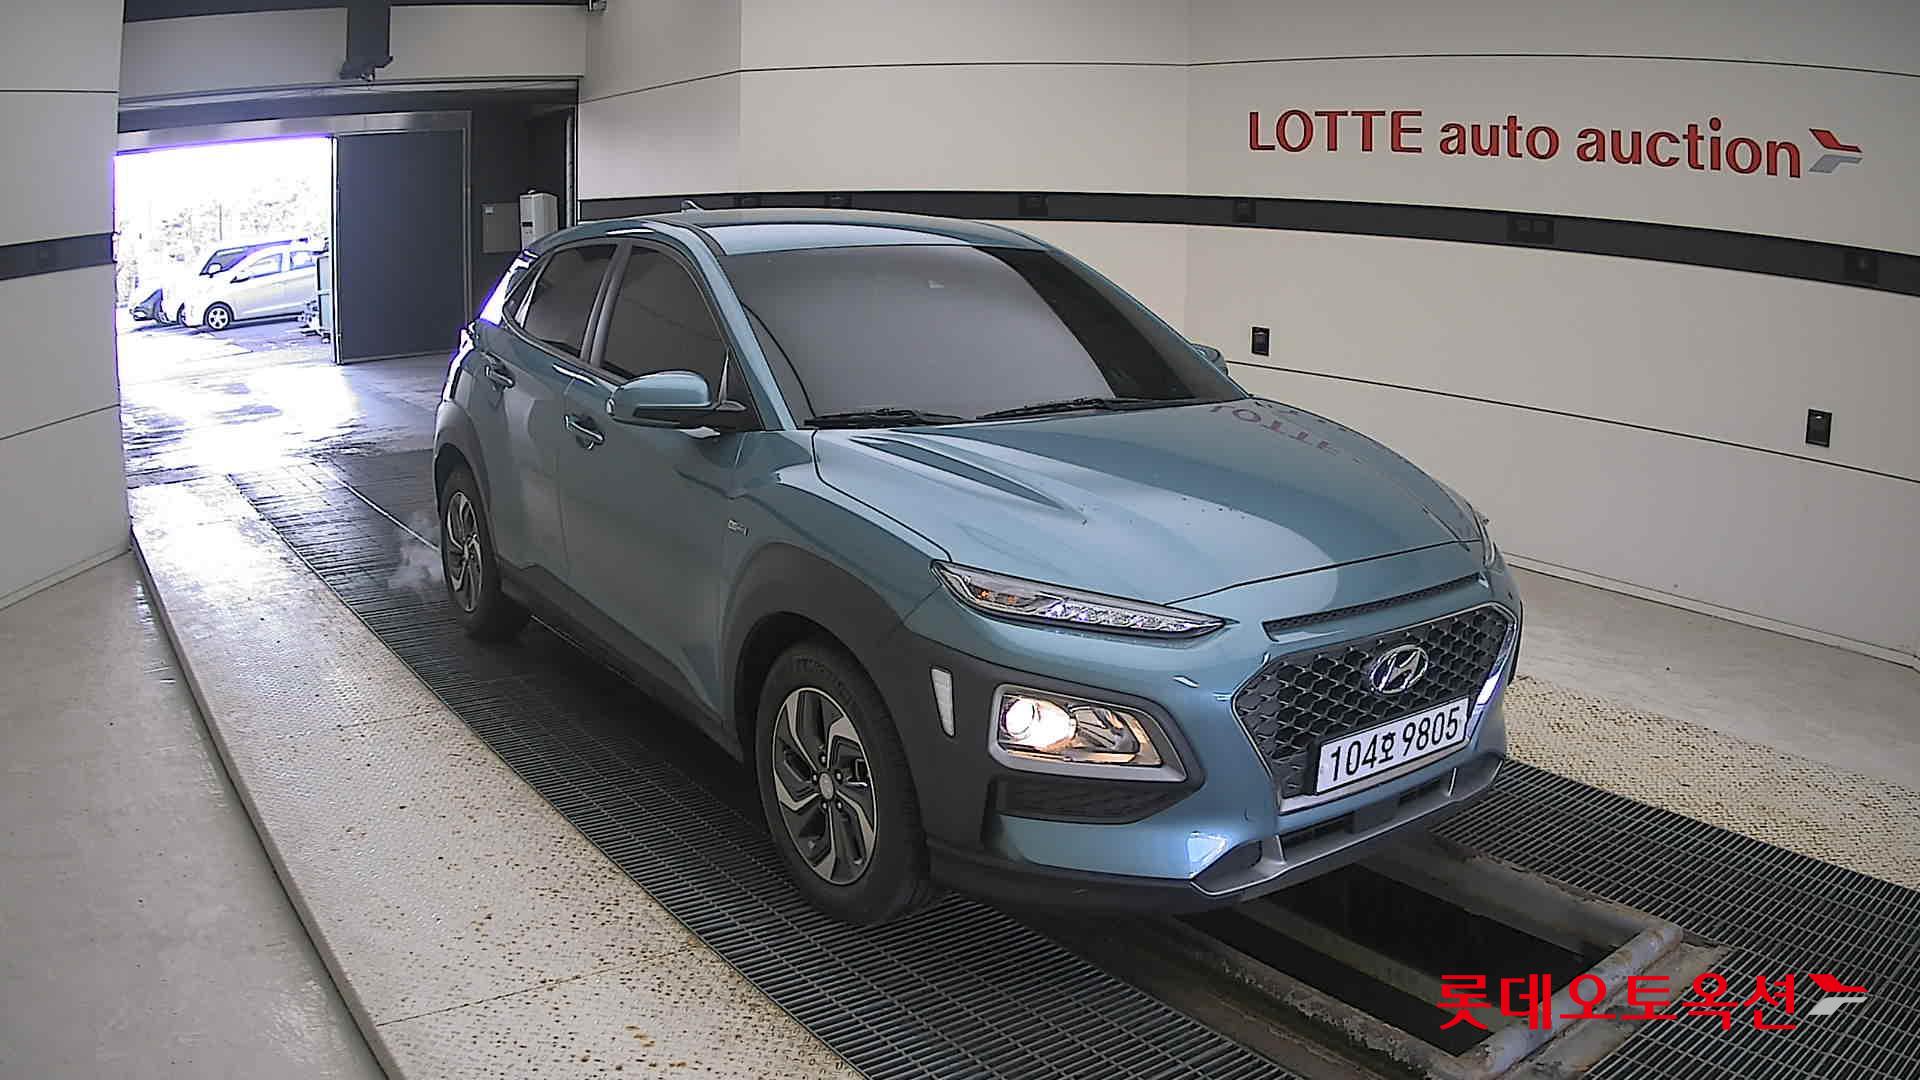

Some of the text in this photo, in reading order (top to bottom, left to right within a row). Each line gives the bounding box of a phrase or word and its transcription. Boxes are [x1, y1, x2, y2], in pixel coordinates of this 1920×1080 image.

[1249, 110, 1801, 178] LOTTE auto auction
[1403, 706, 1460, 757] 9805
